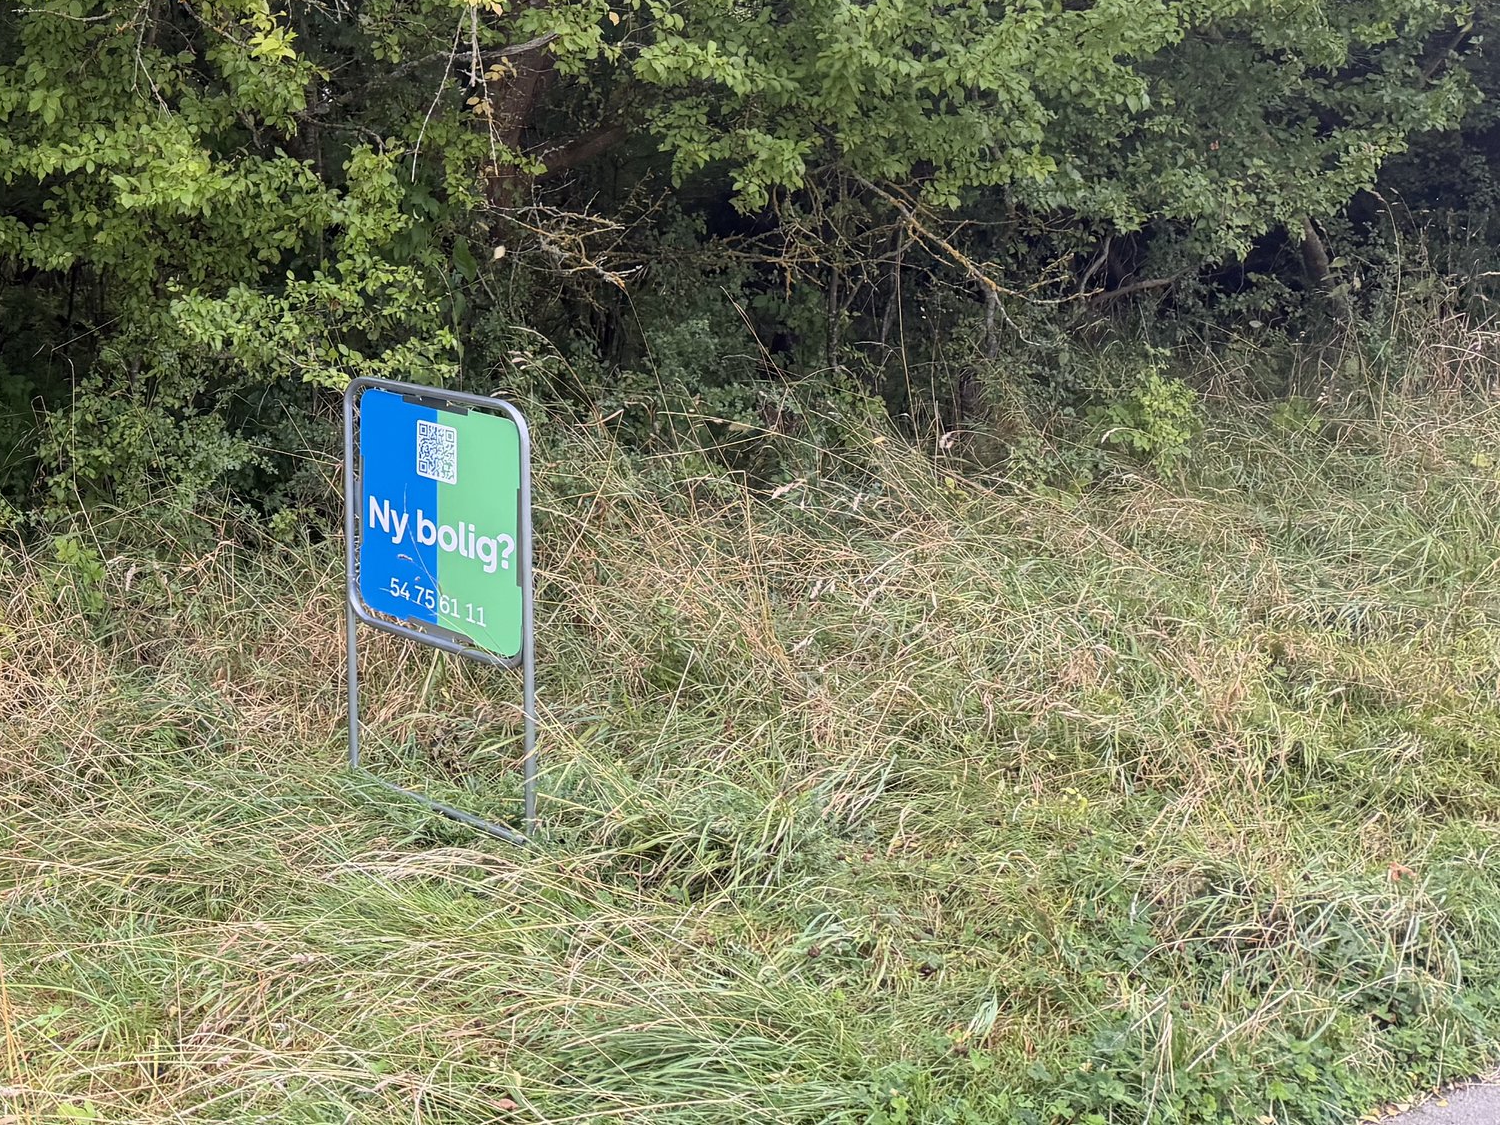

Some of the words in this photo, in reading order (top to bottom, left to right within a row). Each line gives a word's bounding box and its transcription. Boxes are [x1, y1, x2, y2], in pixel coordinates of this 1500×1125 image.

[369, 495, 409, 544] Ny
[416, 509, 515, 573] bolig?
[389, 578, 410, 601] 54
[414, 585, 435, 609] 75
[439, 594, 460, 619] 61
[465, 603, 487, 627] 11
